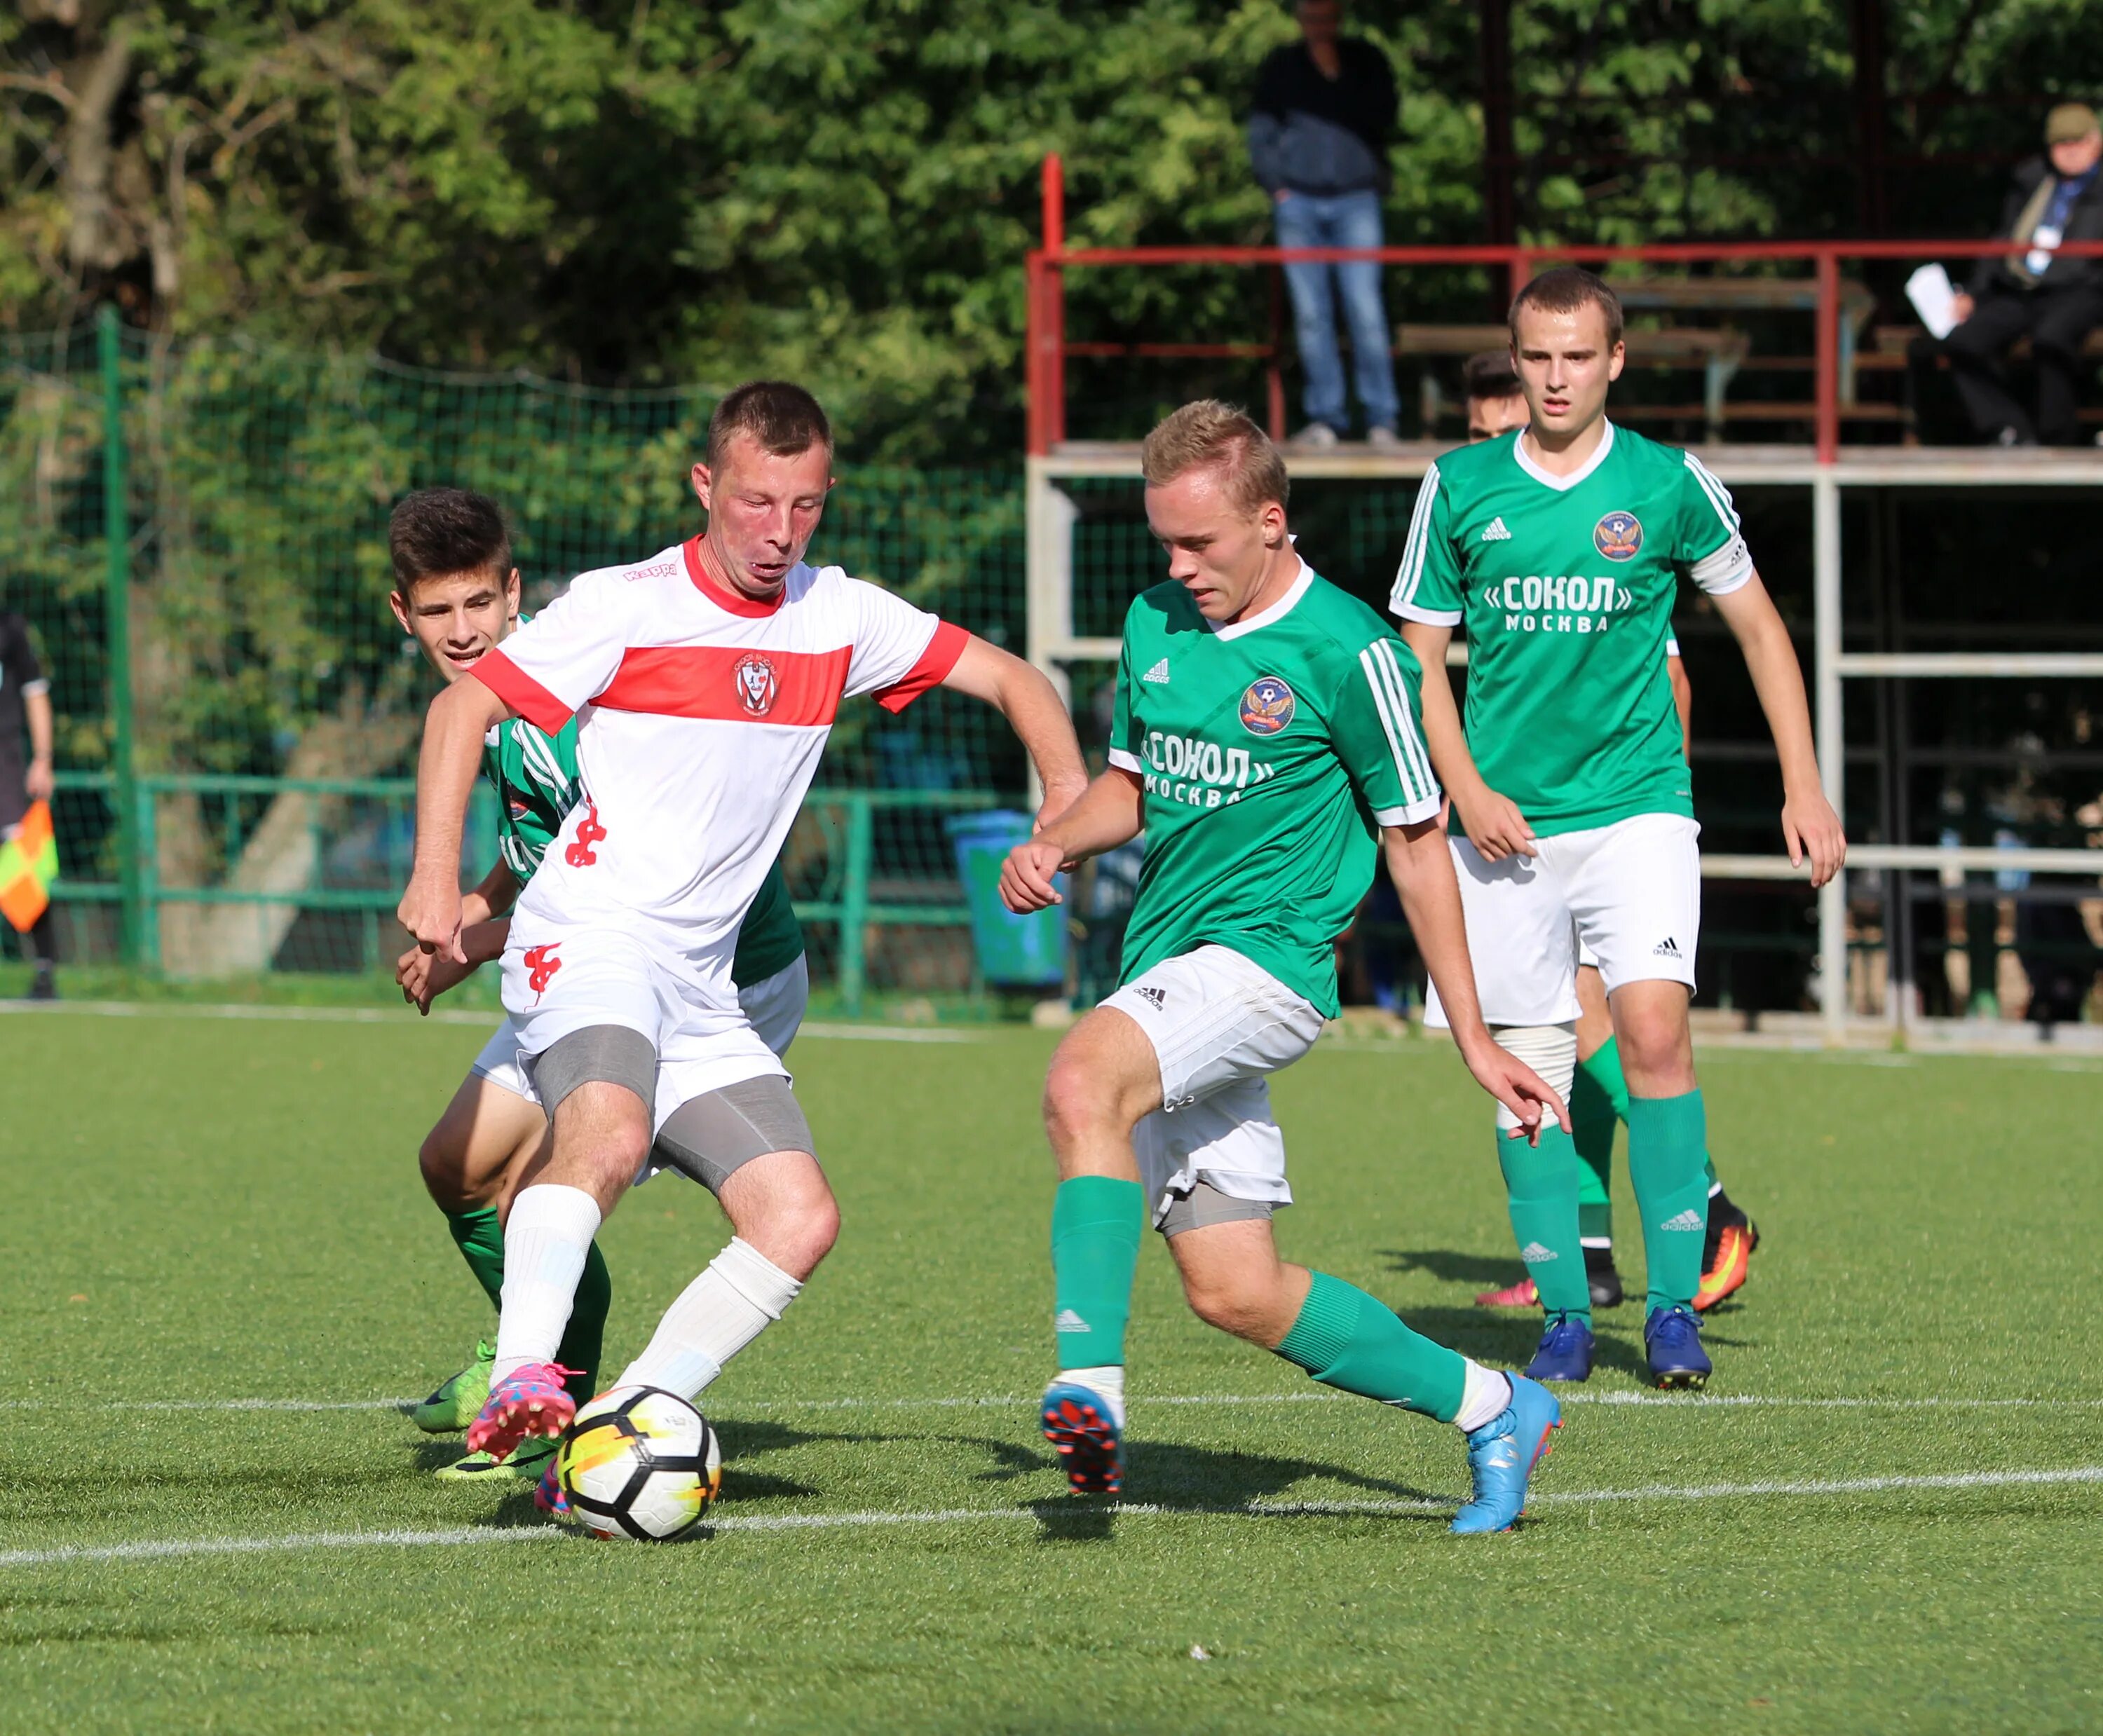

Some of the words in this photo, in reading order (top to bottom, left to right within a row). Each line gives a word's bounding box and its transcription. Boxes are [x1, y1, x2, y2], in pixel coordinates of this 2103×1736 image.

[622, 563, 677, 582] Kappa
[1483, 575, 1632, 613] «СОКОЛ»
[1505, 614, 1608, 634] МОСКВА
[1141, 731, 1275, 788] «СОКОЛ»
[1145, 773, 1241, 807] МОСКВА
[1653, 948, 1682, 959] adidas
[1133, 988, 1164, 1011] adidas
[1660, 1222, 1704, 1231] adidas
